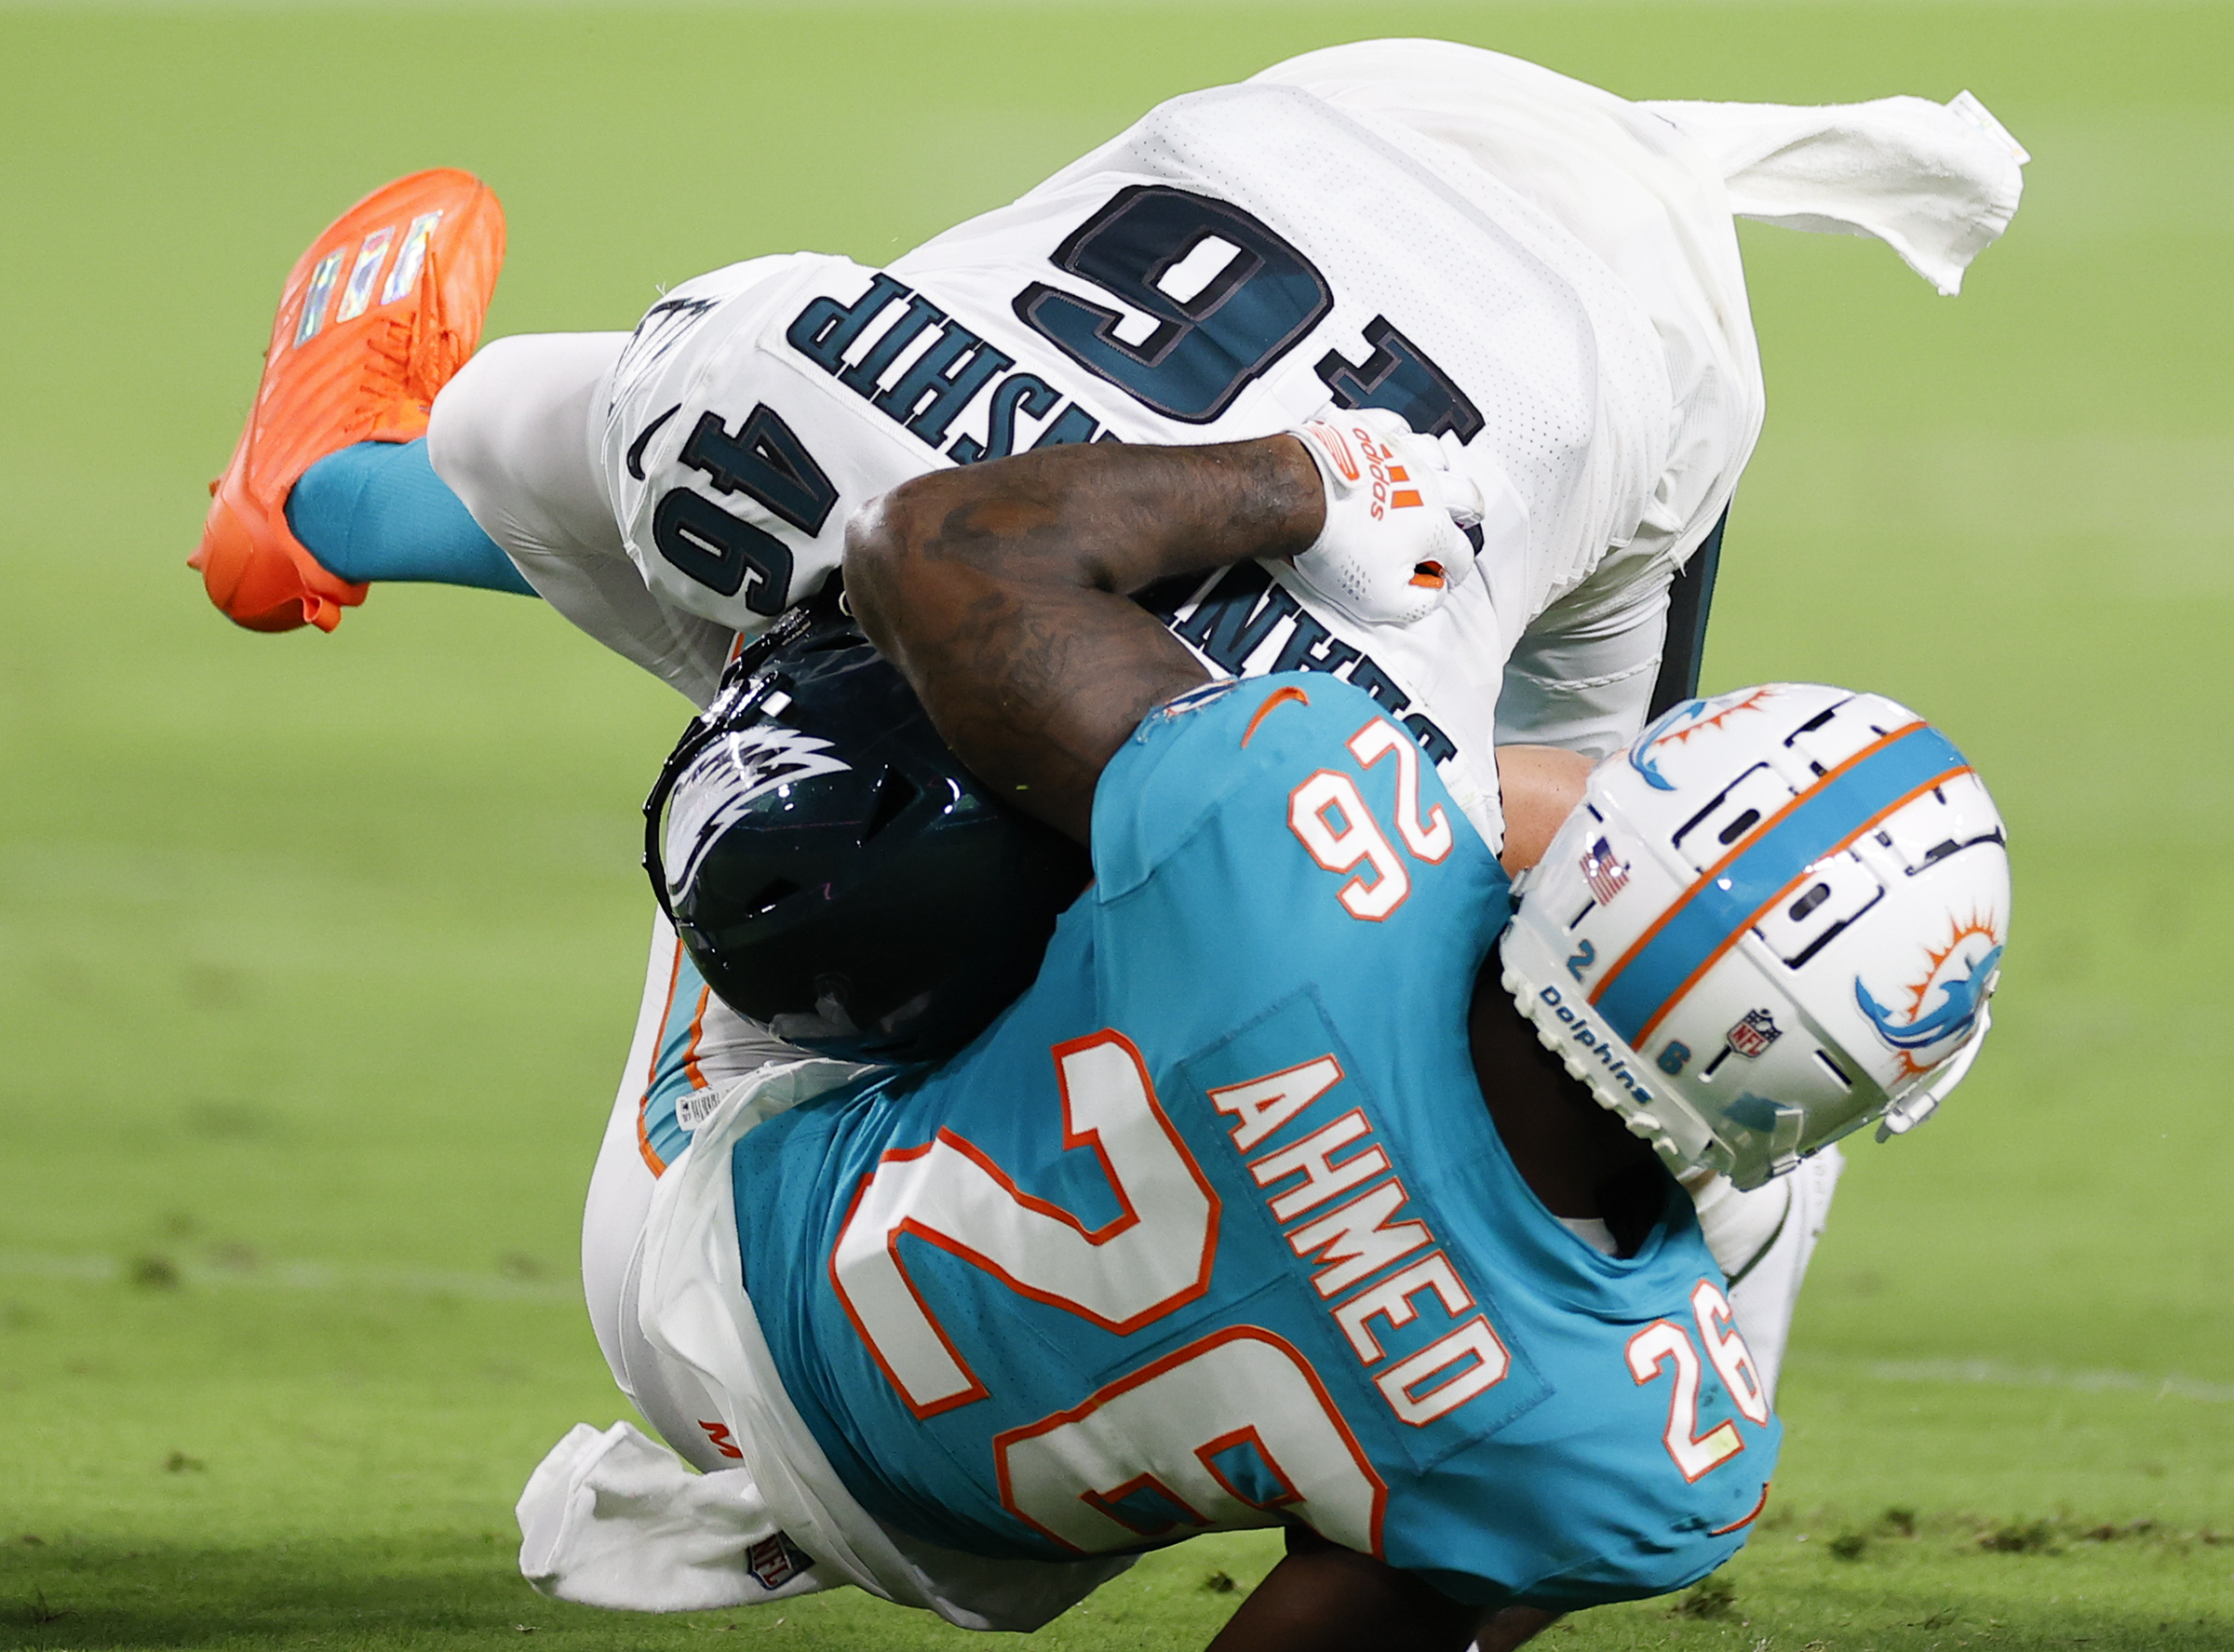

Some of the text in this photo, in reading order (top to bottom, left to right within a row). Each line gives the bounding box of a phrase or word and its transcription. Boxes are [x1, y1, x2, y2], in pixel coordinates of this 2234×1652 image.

[653, 401, 840, 617] 46
[1353, 428, 1390, 521] adidas
[1286, 715, 1454, 923] 26
[1540, 985, 1654, 1105] Dolphins
[1729, 1022, 1769, 1056] NFL
[829, 1027, 1388, 1562] 26
[1206, 1054, 1511, 1428] AHMED
[1624, 1279, 1769, 1484] 26
